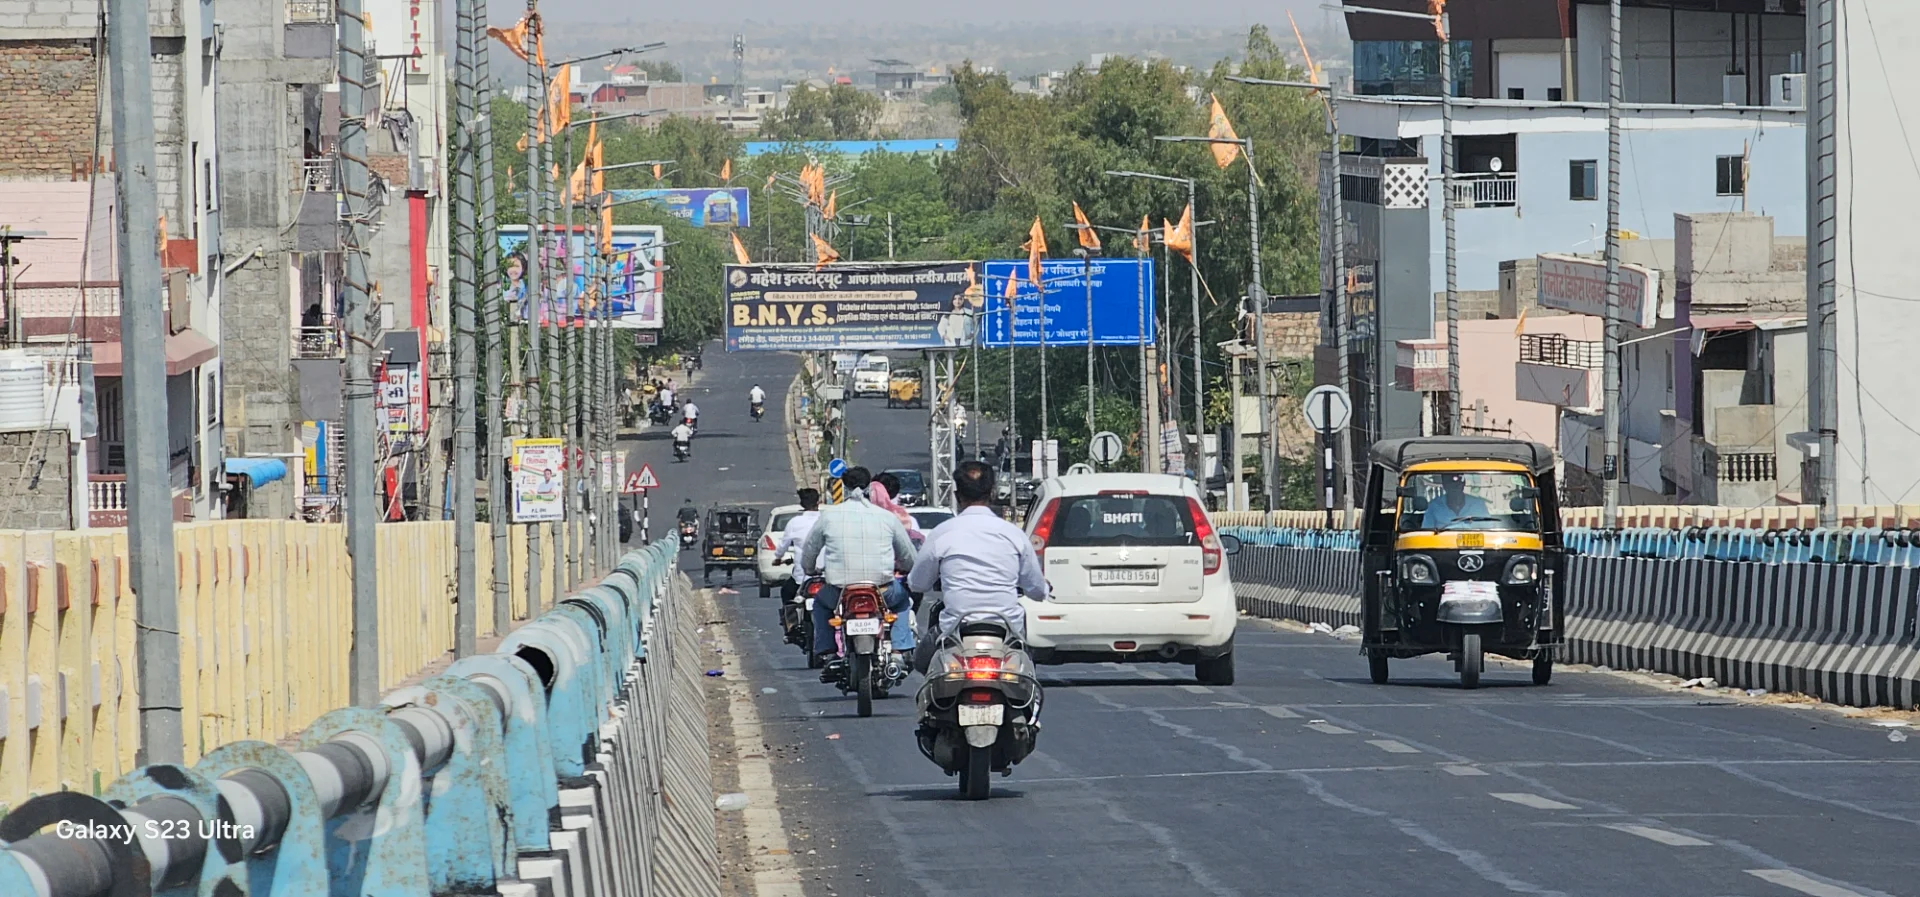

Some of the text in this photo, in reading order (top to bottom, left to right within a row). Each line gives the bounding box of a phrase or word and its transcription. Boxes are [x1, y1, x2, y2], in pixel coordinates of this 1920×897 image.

[750, 269, 782, 287] महेश
[733, 304, 836, 326] B.N.Y.S.
[1103, 513, 1143, 524] BHATI
[1186, 532, 1193, 544] 7
